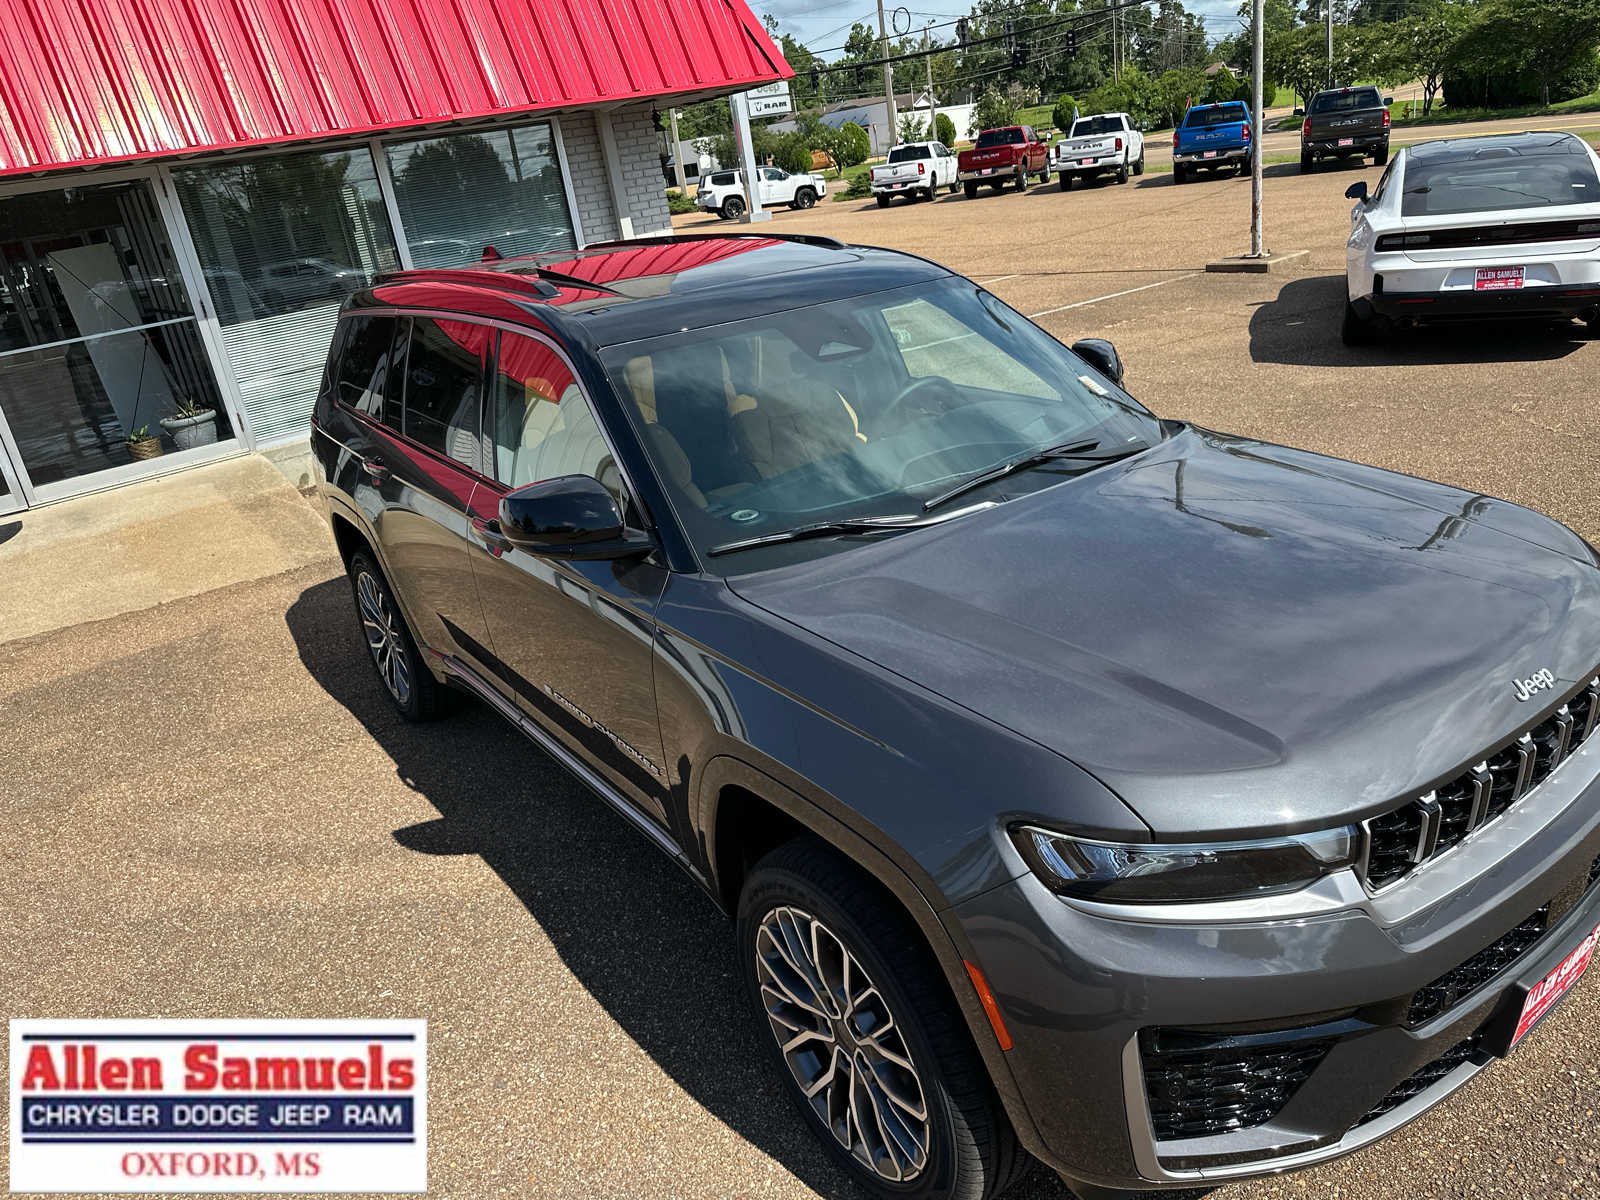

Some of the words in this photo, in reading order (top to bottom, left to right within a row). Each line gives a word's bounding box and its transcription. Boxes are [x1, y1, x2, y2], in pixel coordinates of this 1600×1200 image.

[764, 101, 787, 109] RAM
[1477, 271, 1496, 280] ALLEN
[1497, 269, 1523, 279] SAMUELS
[1513, 667, 1555, 702] Jeep
